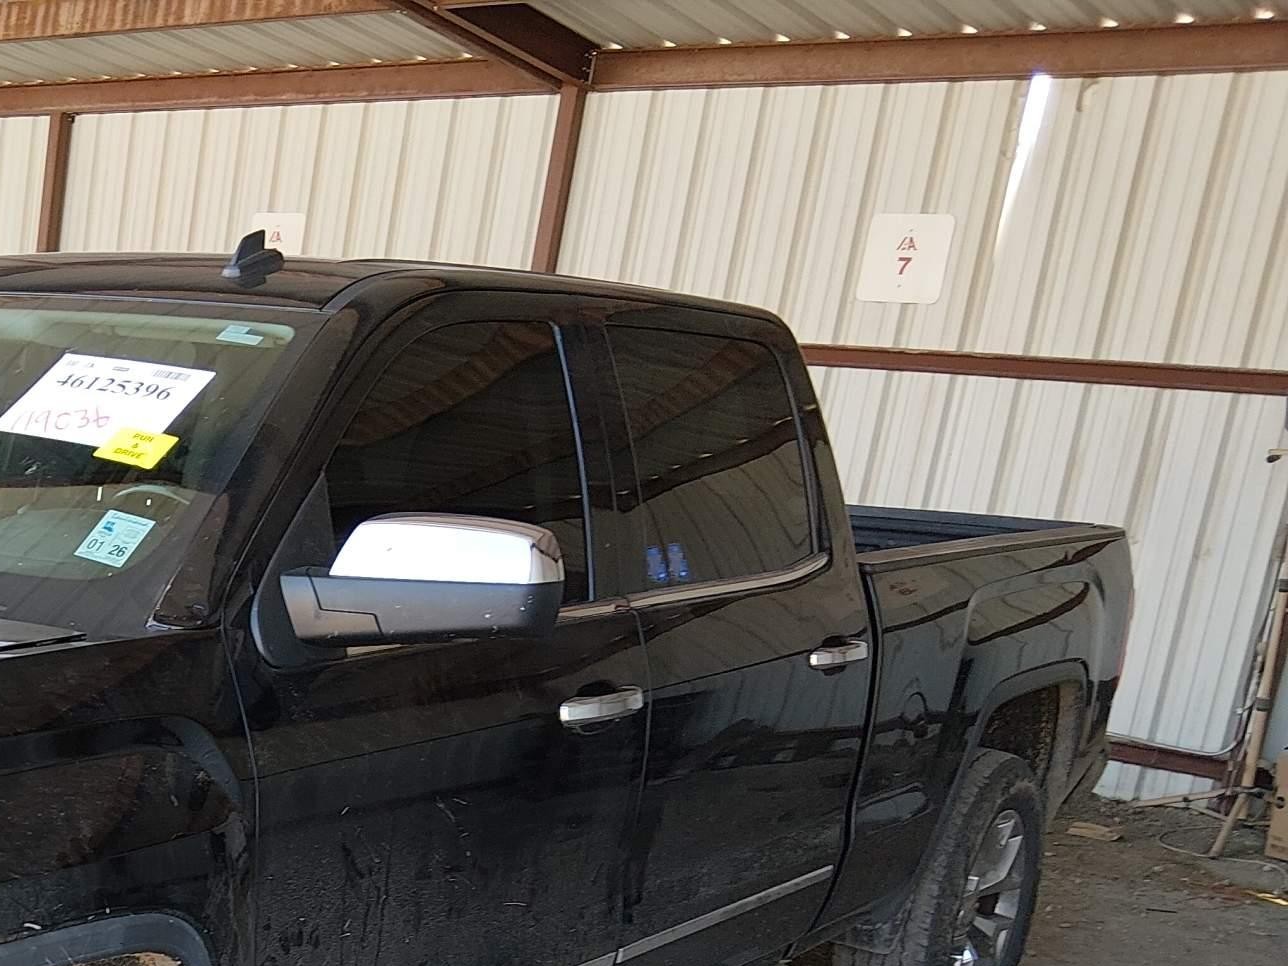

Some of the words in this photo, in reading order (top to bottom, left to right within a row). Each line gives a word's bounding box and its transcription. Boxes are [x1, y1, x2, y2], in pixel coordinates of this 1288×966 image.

[897, 256, 913, 275] 7
[56, 373, 176, 401] 46125396
[113, 448, 145, 459] DRIVE
[86, 538, 105, 552] 01
[107, 544, 128, 558] 26
